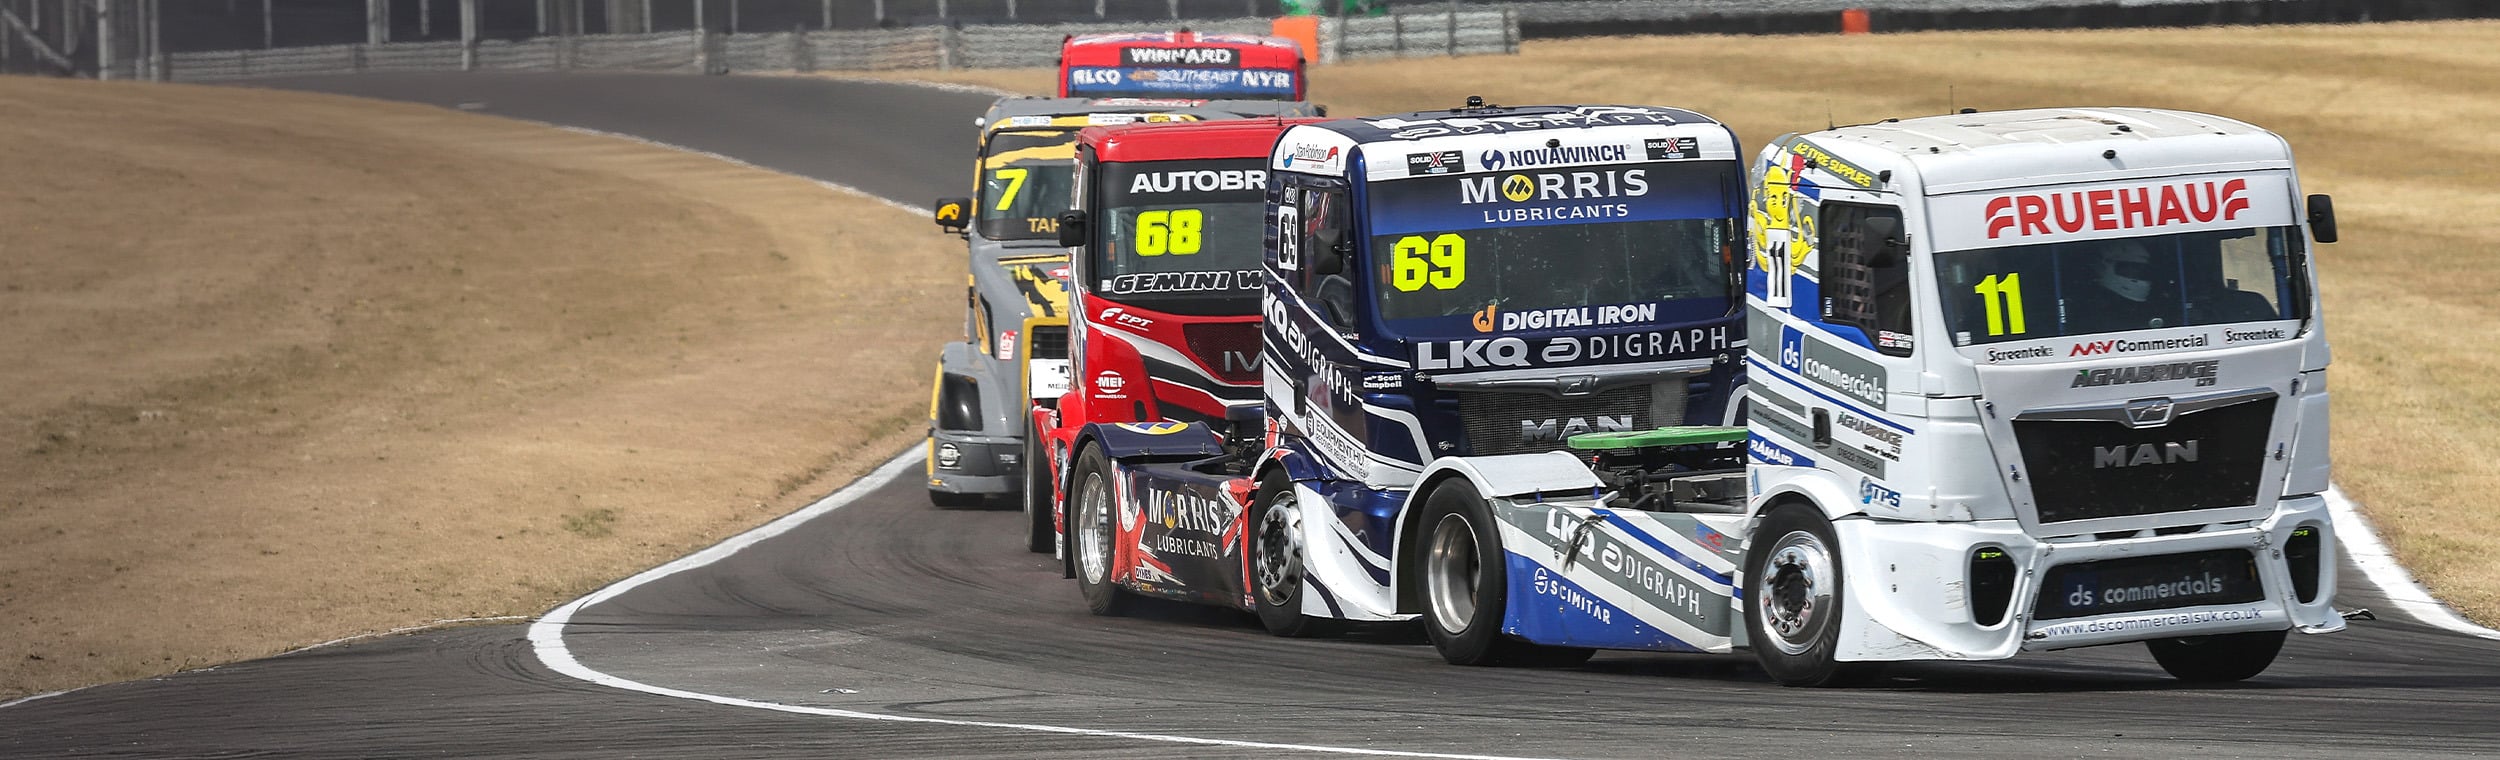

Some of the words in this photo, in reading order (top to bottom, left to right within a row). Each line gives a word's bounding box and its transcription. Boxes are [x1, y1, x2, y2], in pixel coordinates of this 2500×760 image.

[1510, 144, 1627, 167] NOVAWINCH
[995, 169, 1028, 211] 7
[1130, 169, 1266, 194] AUTOBR
[1460, 169, 1650, 205] MORRIS
[1484, 203, 1629, 223] LUBRICANTS
[1985, 178, 2250, 240] FRUEHAUF
[1136, 209, 1203, 257] 68
[1278, 213, 1297, 265] 69
[1392, 232, 1466, 292] 69
[1769, 241, 1786, 297] 11
[1112, 271, 1232, 295] GEMINI
[1502, 308, 1594, 331] DIGITAL
[1597, 303, 1657, 325] IRON
[1974, 272, 2027, 336] 11
[1117, 313, 1153, 327] FPT
[2224, 327, 2280, 343] Screentek
[1417, 337, 1532, 371] LKQ
[1590, 326, 1728, 360] DIGRAPH
[1988, 346, 2048, 362] Screentek
[2116, 333, 2209, 353] Commercial
[1098, 377, 1122, 388] MEI
[1300, 338, 1352, 405] DIGRAPH
[1363, 381, 1402, 390] Campbell
[1377, 374, 1402, 382] Scott
[1783, 341, 1799, 369] ds
[1804, 357, 1885, 405] commercials
[2071, 360, 2220, 389] AGHABRIDGE
[1521, 414, 1633, 441] MAN
[2093, 439, 2200, 470] MAN
[1148, 487, 1221, 536] MORRIS
[1157, 534, 1219, 560] LUBRICANTS
[1545, 507, 1597, 563] LKQ
[1625, 556, 1701, 617] DIGRAPH
[1550, 581, 1611, 625] SCIMITAR
[2068, 585, 2094, 607] ds
[2104, 572, 2223, 604] commercials
[2046, 608, 2264, 637] www.dscommercialsuk.co.uk
